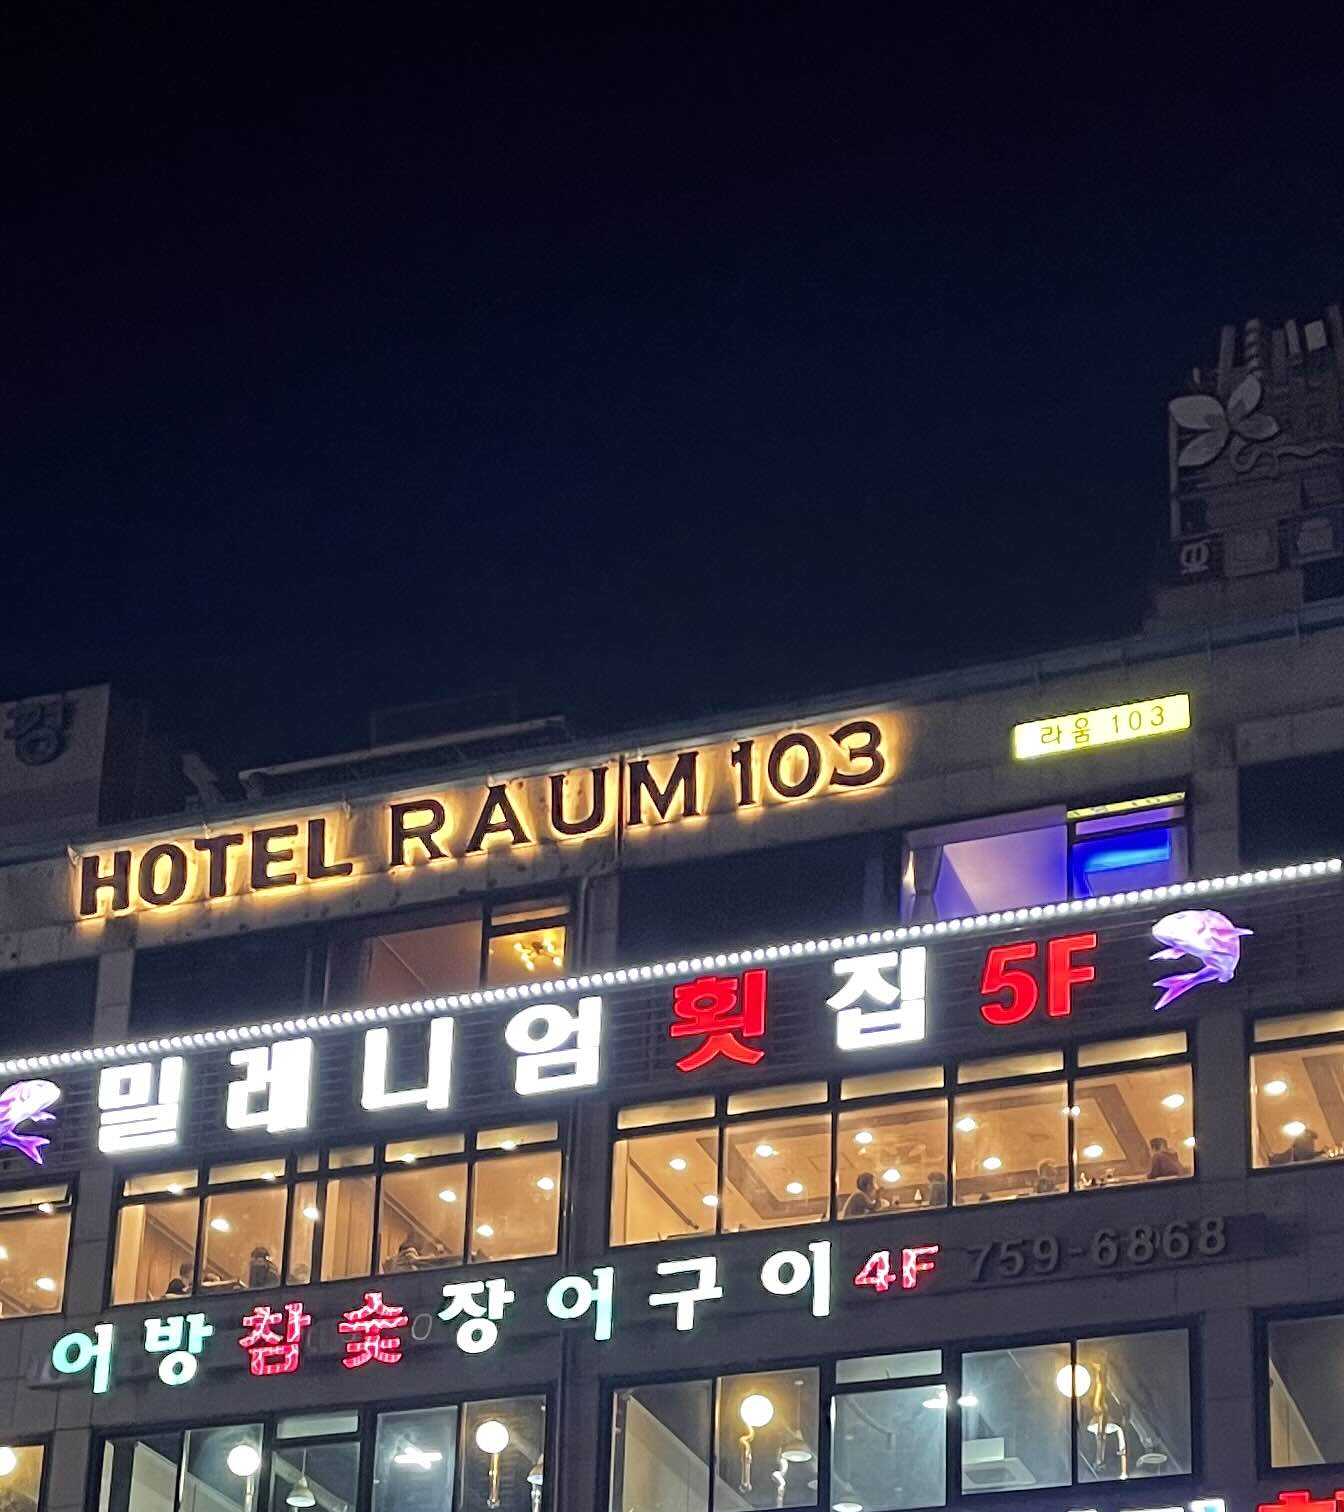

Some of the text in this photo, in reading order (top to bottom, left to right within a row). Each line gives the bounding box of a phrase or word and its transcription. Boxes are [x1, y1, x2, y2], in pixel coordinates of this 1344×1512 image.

[1039, 704, 1167, 746] 라움 103
[78, 719, 887, 917] HOTEL RAUM 103
[981, 931, 1097, 1024] 5F
[853, 1243, 940, 1294] 4F
[965, 1216, 1228, 1282] 759-6868
